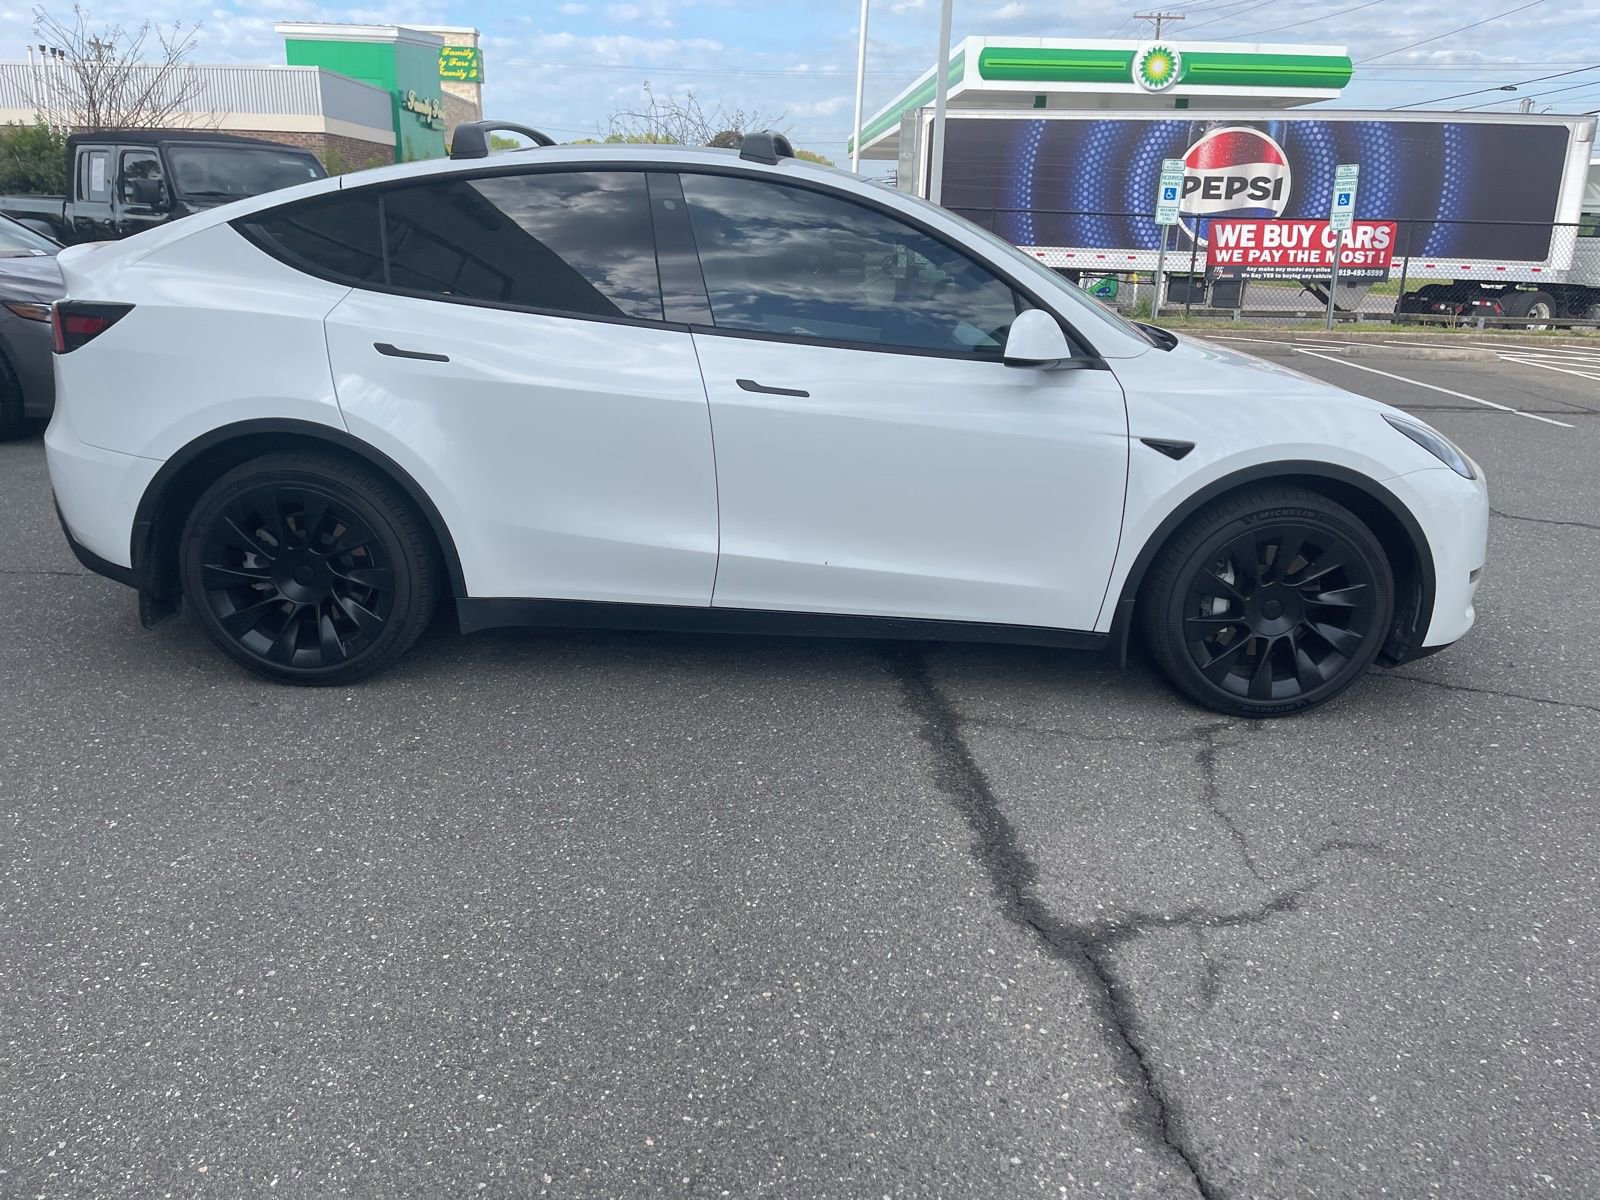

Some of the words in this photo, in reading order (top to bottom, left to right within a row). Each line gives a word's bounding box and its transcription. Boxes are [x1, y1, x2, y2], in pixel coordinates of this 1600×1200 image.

[442, 47, 474, 59] Family
[1181, 176, 1284, 201] PEPSI
[1215, 224, 1257, 248] WE
[1262, 224, 1317, 248] BUY
[1321, 225, 1391, 250] CARS
[1215, 249, 1244, 264] WE
[1247, 249, 1284, 264] PAY
[1287, 250, 1322, 264] THE
[1325, 250, 1376, 265] MOST
[1258, 508, 1316, 520] MICHELIN
